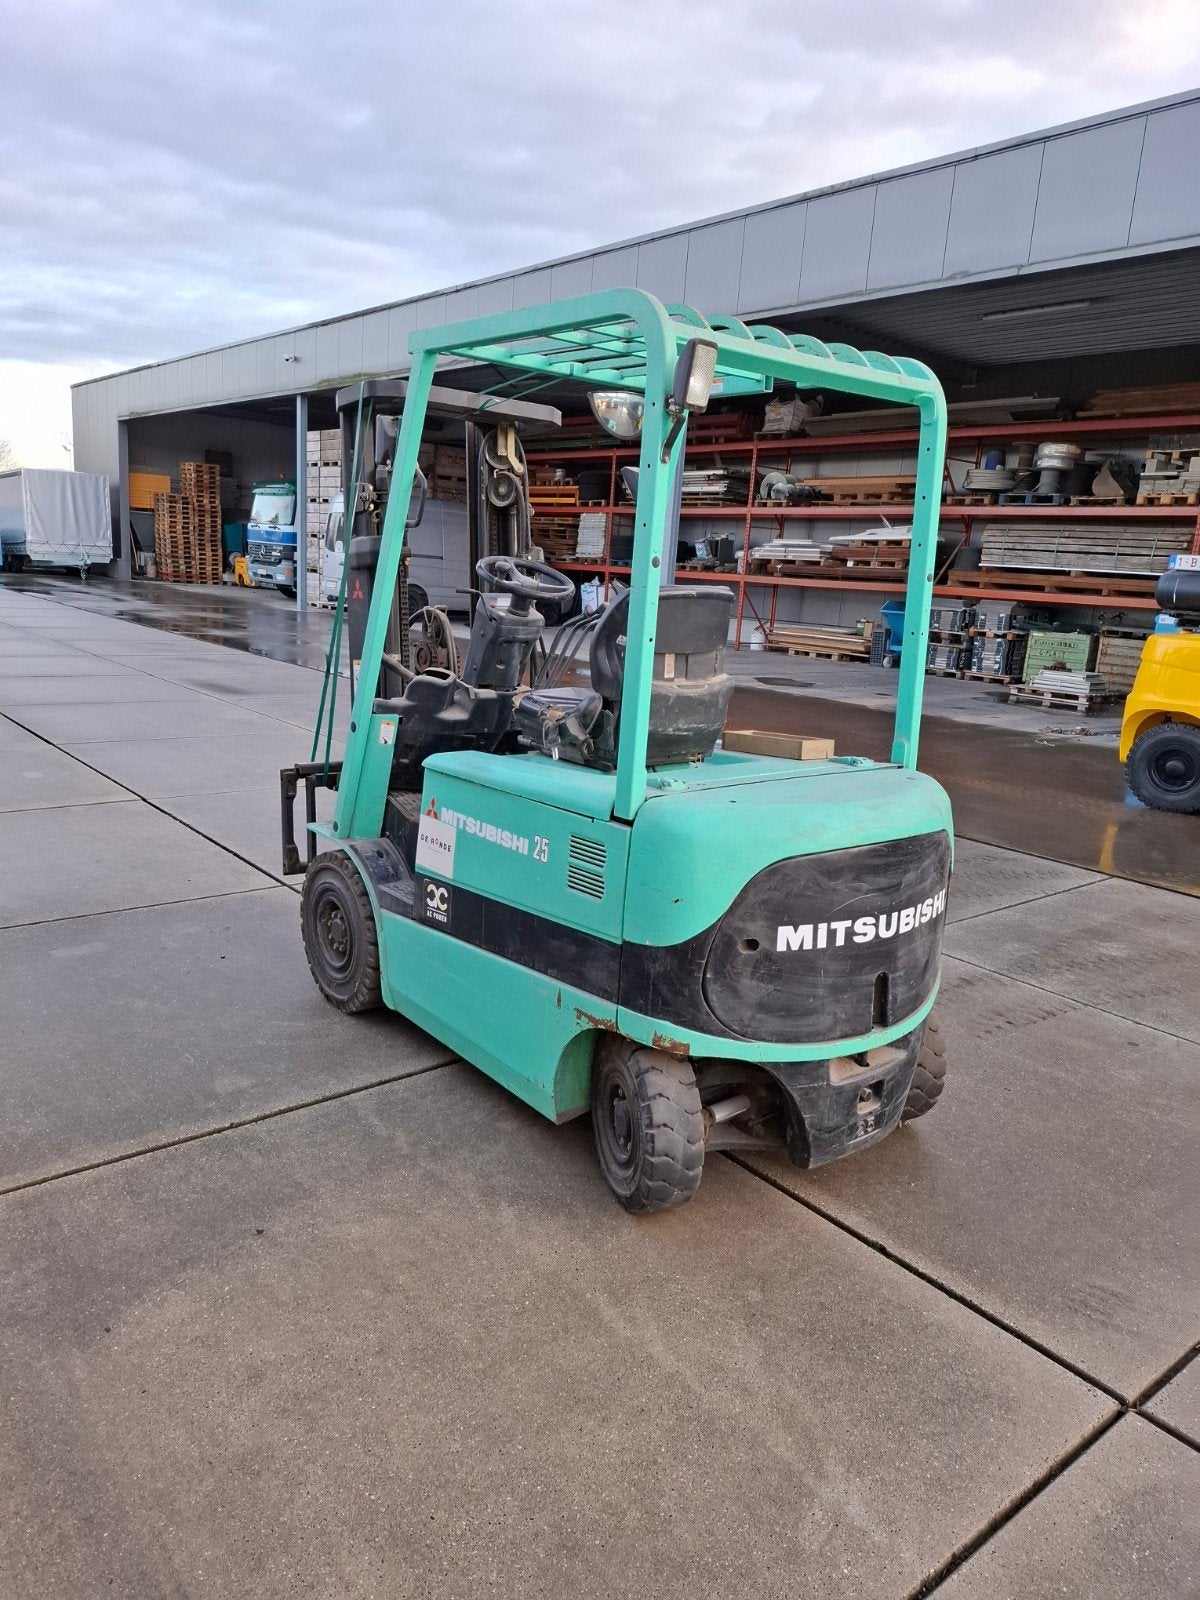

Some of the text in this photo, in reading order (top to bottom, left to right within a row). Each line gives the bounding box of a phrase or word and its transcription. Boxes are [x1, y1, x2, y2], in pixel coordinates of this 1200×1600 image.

[421, 833, 429, 843] DE
[441, 807, 550, 863] MITSUBISHI 25
[776, 888, 946, 952] MITSUBISHI
